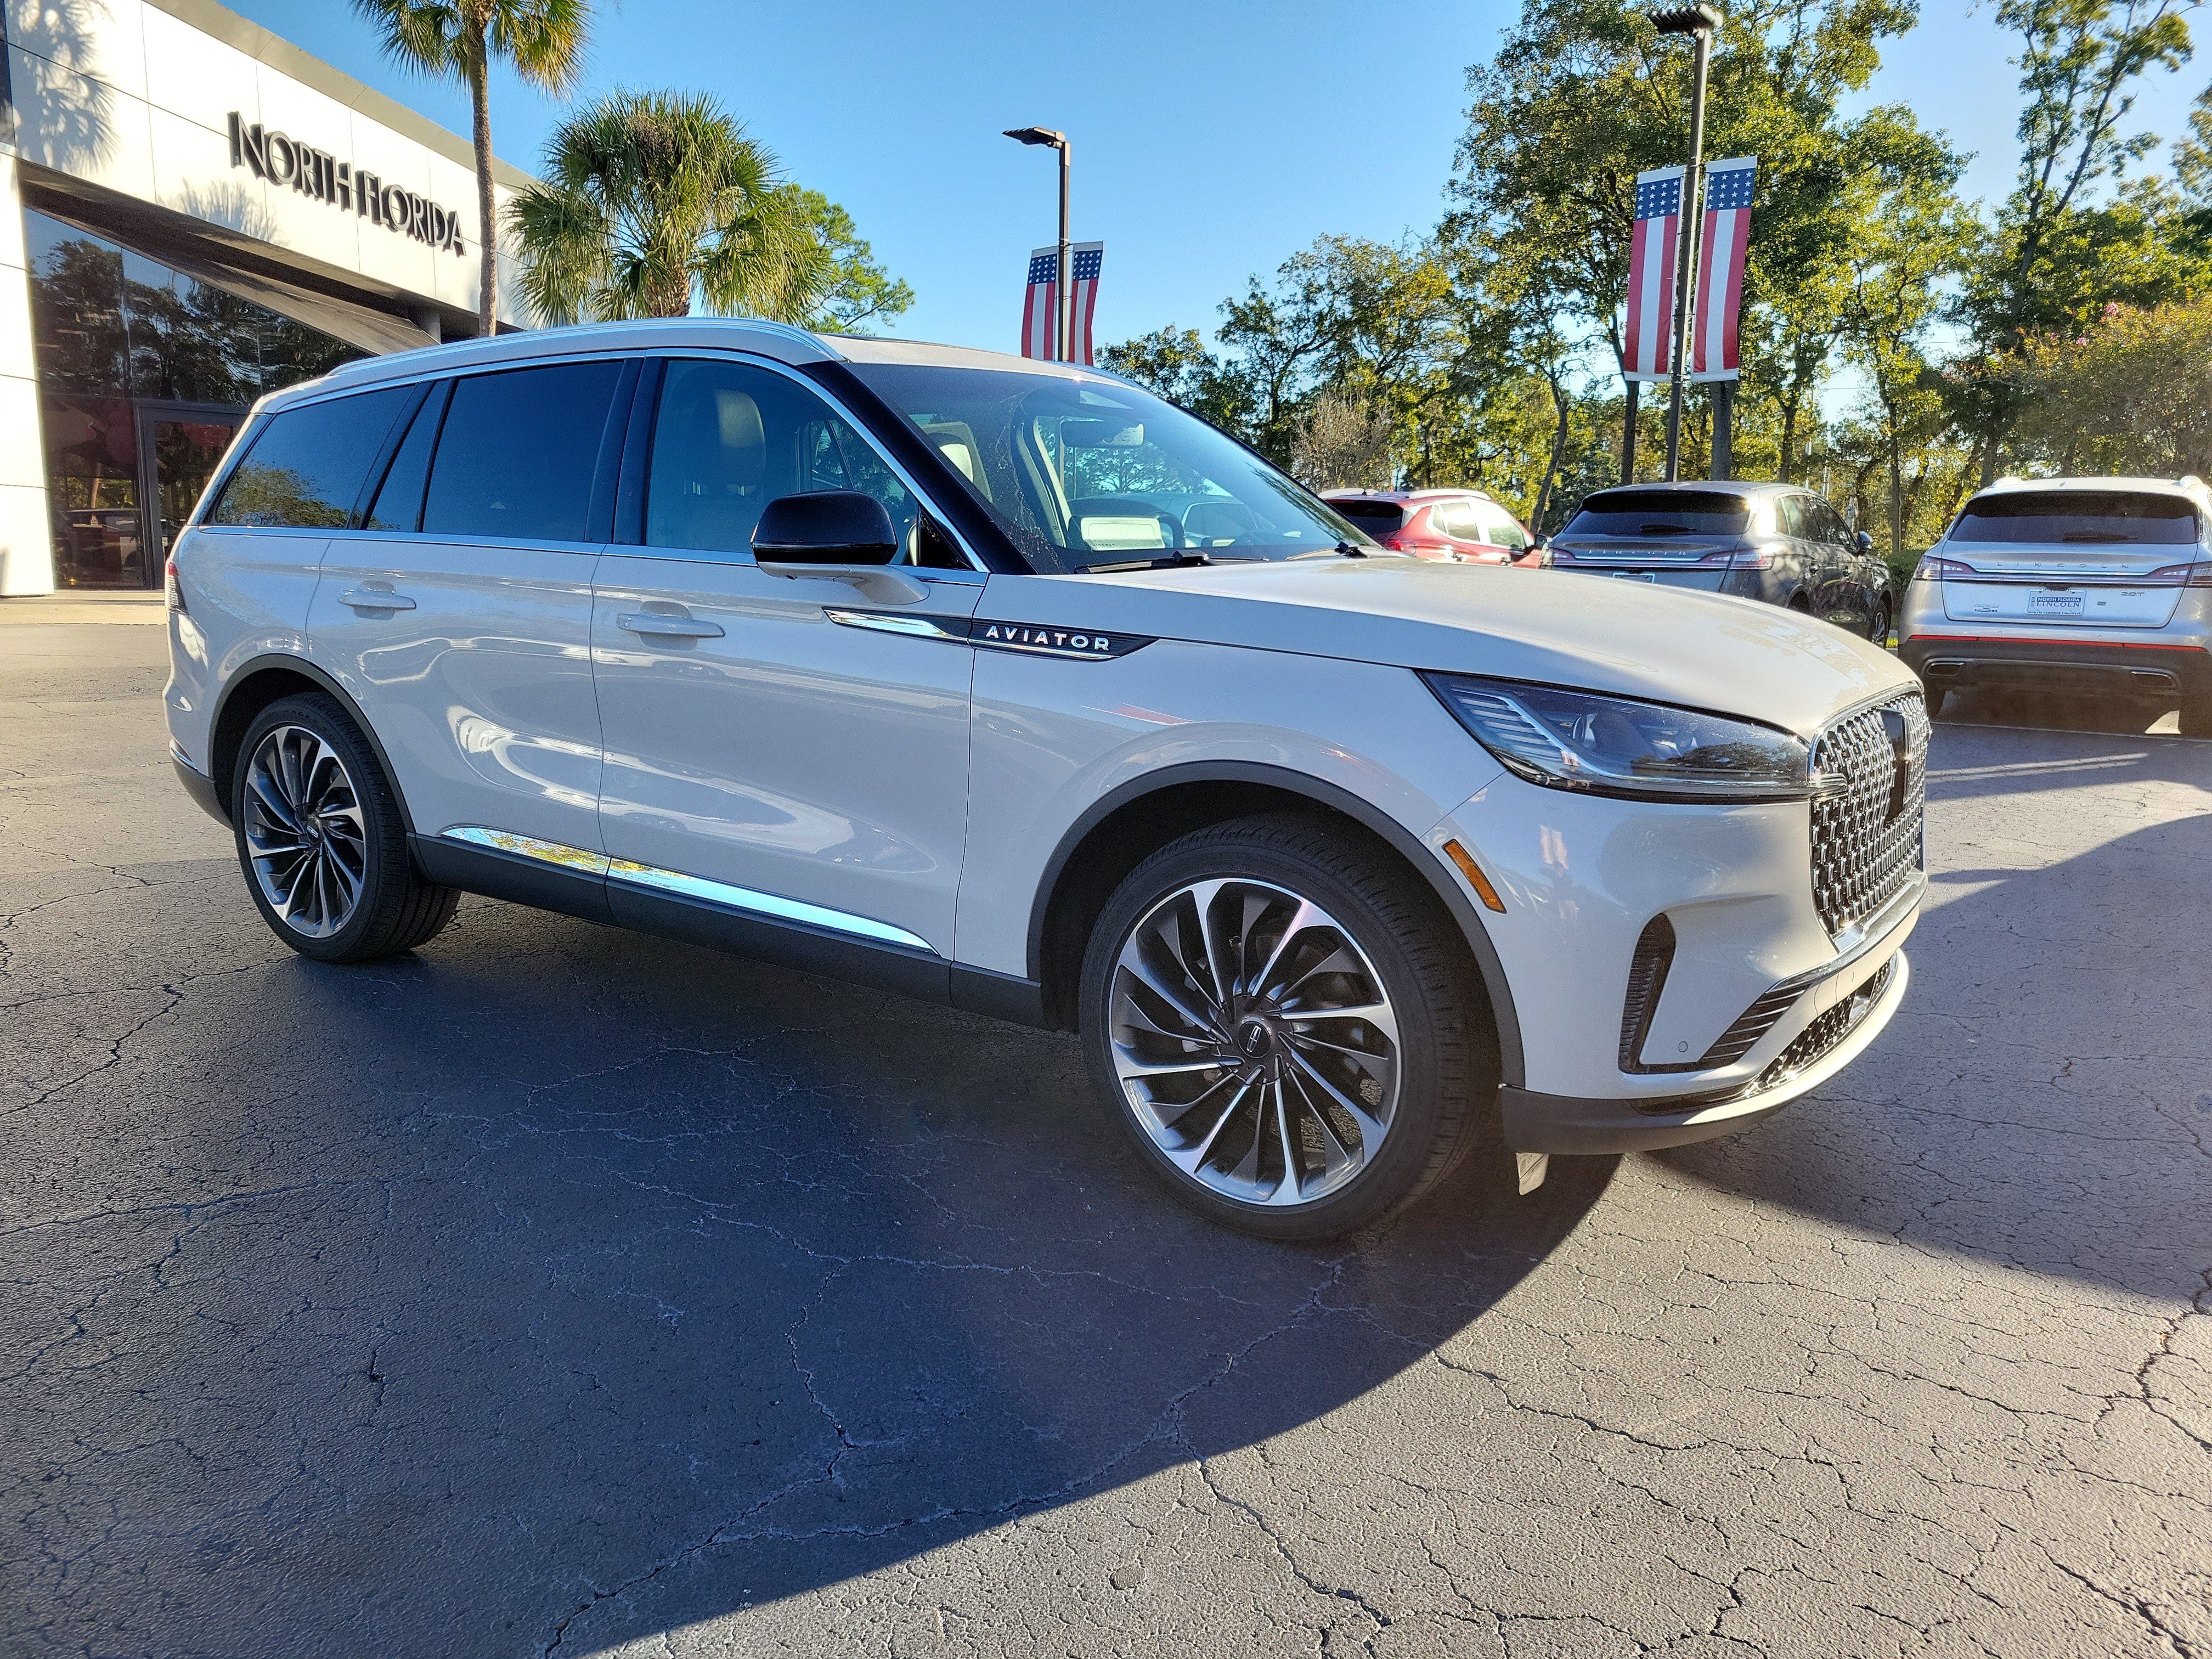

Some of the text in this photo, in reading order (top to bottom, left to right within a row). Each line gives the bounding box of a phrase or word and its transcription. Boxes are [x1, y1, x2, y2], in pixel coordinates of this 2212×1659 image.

[227, 111, 466, 257] NORTH FLORIDA
[986, 625, 1109, 651] AVIATOR
